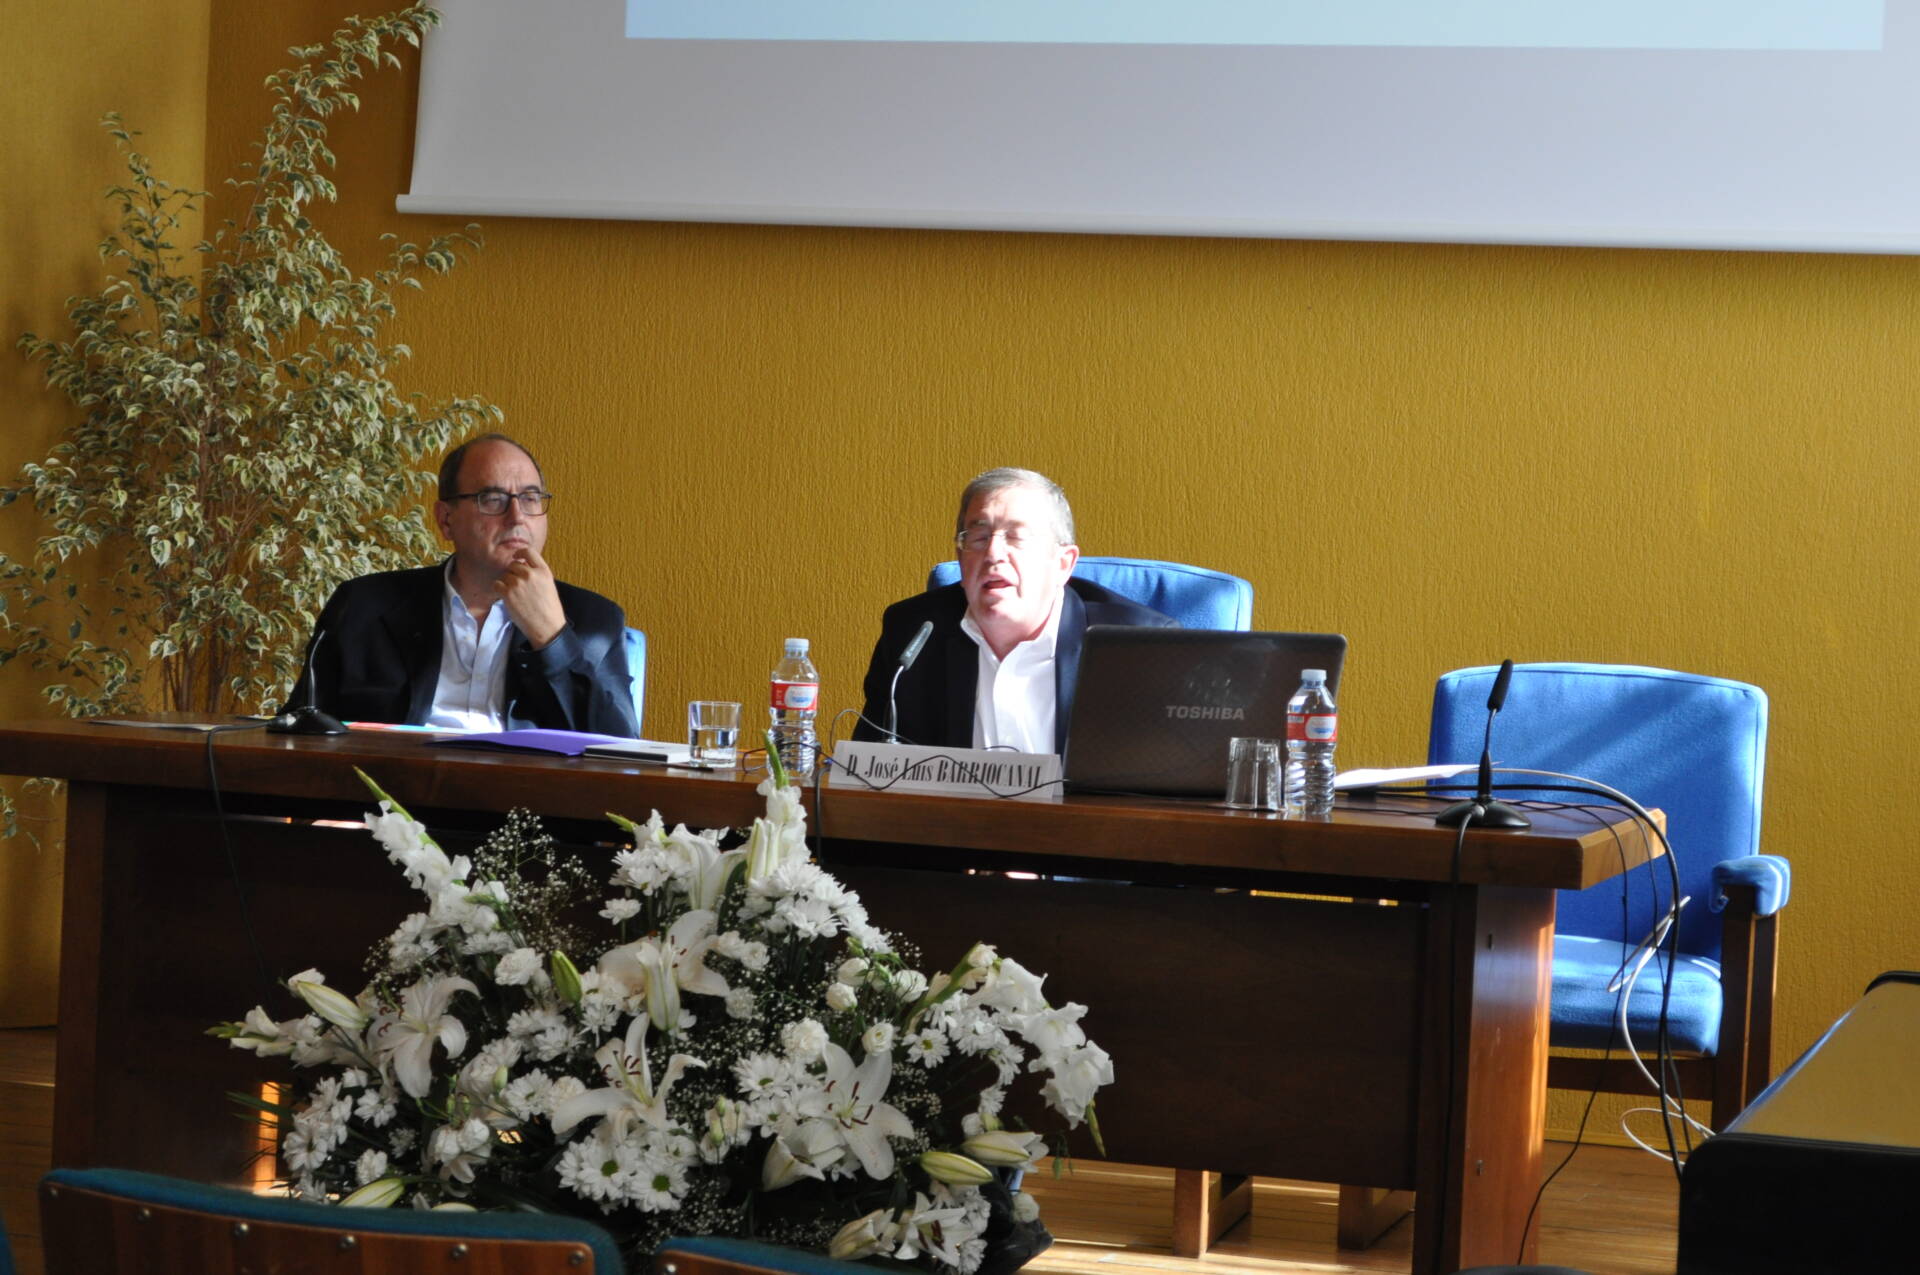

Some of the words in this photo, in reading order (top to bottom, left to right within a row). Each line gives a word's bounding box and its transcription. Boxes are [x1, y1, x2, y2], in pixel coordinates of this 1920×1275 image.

[1166, 705, 1245, 720] TOSHIBA
[864, 755, 898, 779] José
[903, 757, 934, 782] Luis
[936, 759, 1042, 788] BARRIOCANAL
